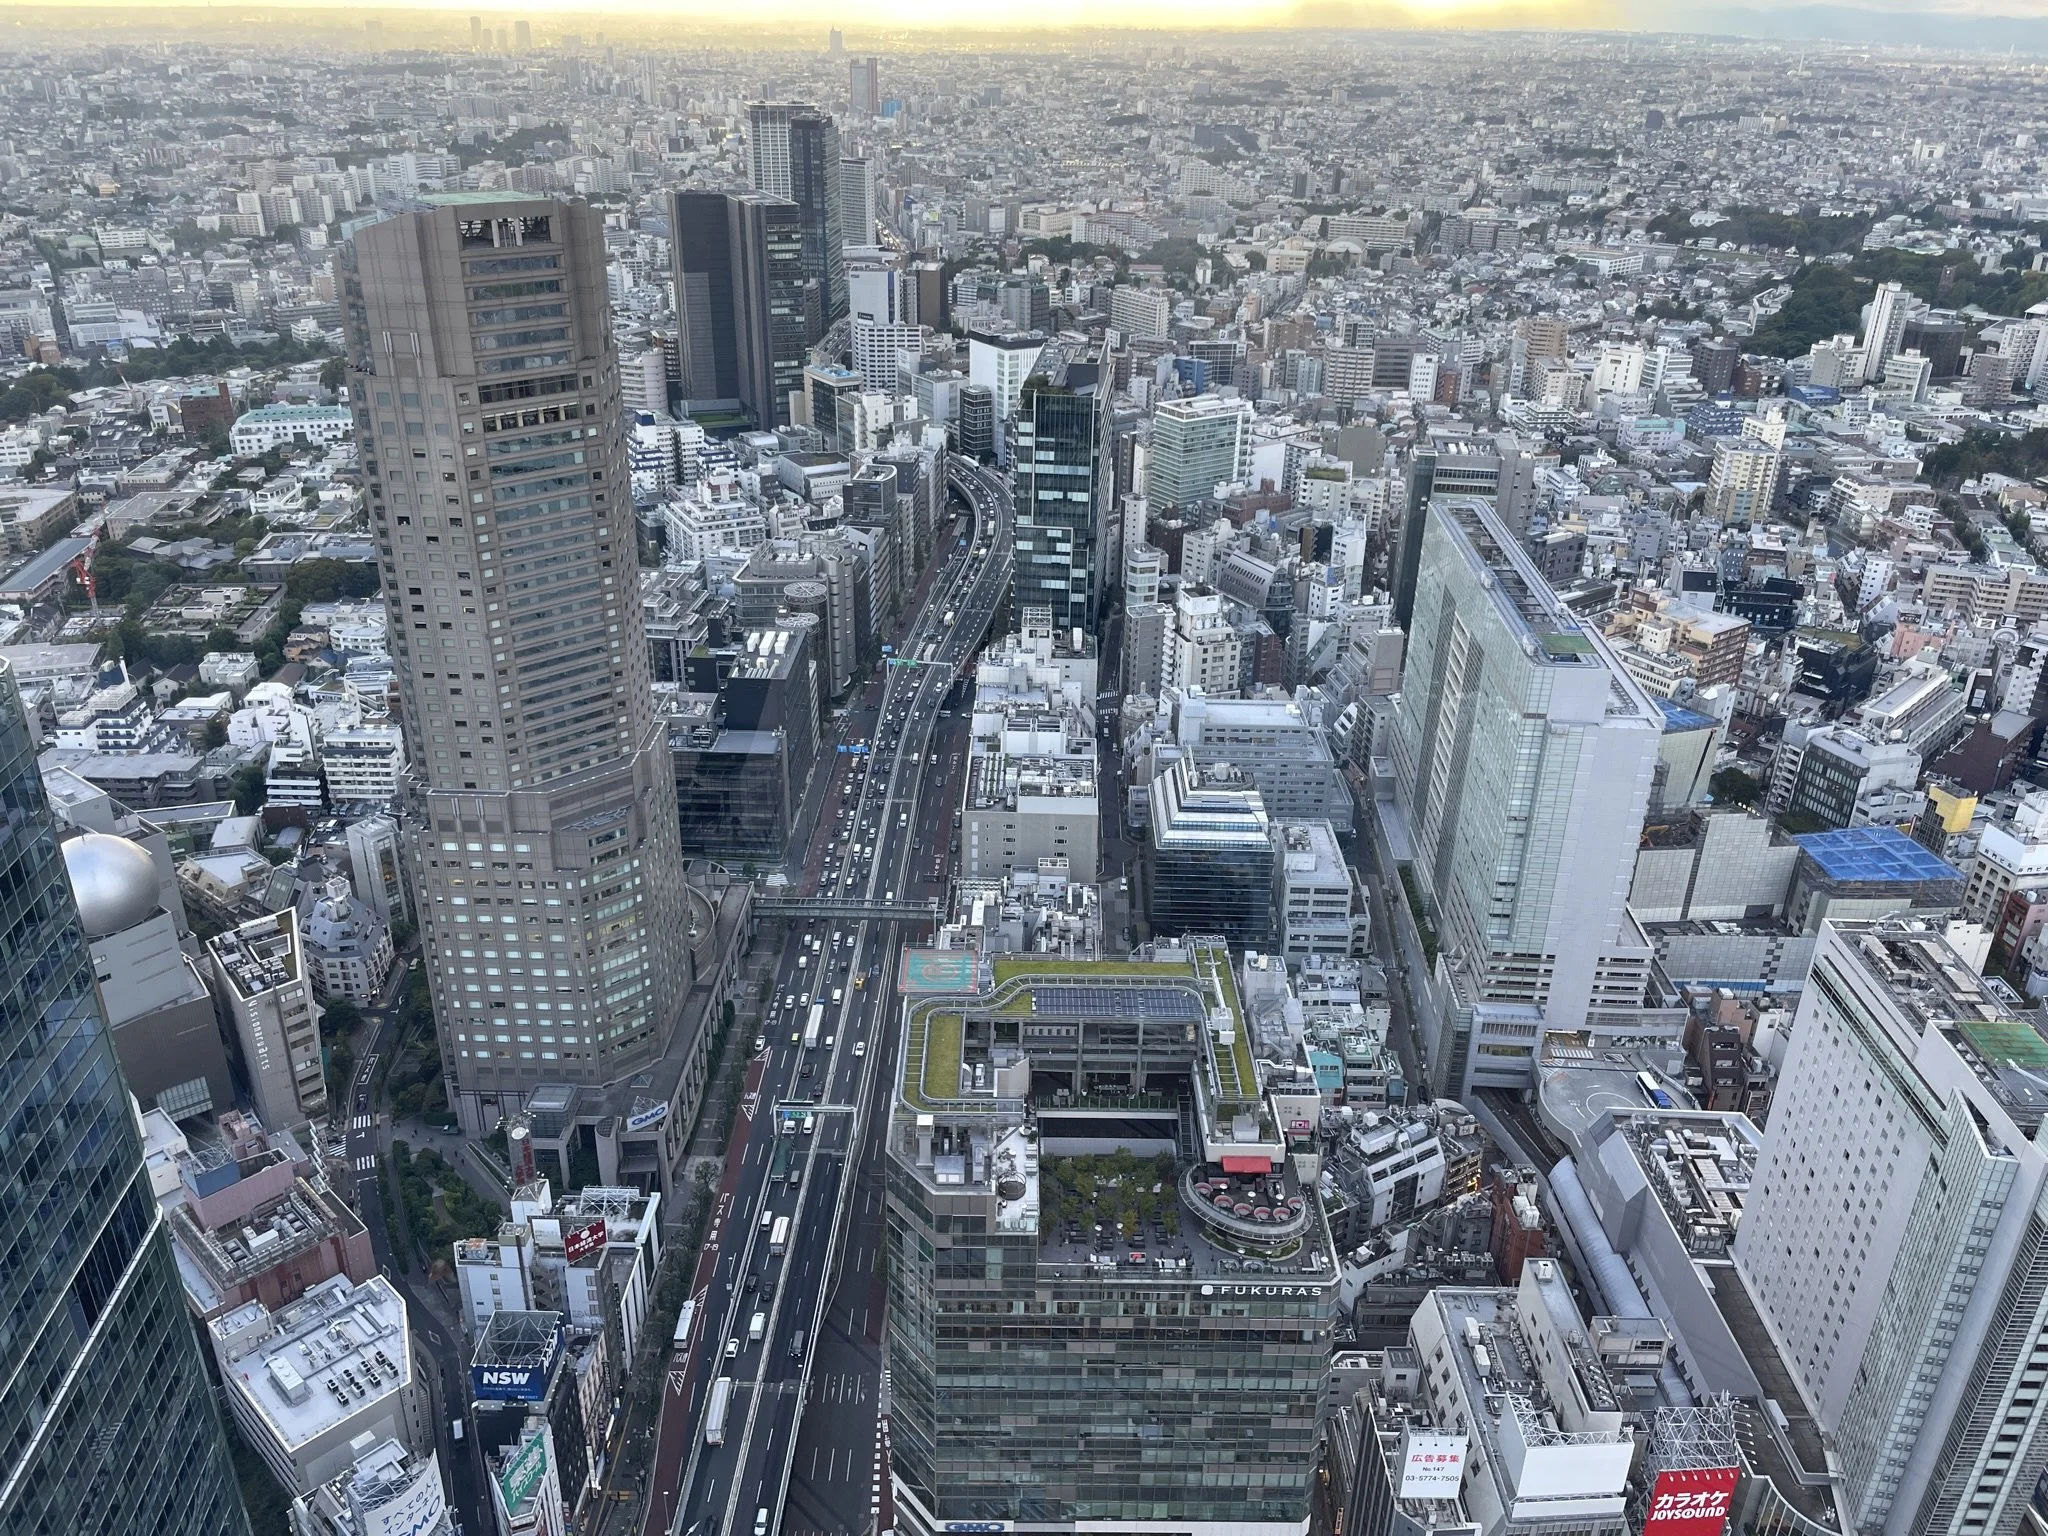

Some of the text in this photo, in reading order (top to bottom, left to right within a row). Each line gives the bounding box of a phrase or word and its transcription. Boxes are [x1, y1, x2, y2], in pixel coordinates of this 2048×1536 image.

[631, 1106, 666, 1126] GMO
[1221, 1285, 1322, 1296] FUKURAS
[482, 1371, 530, 1385] NSW
[1411, 1454, 1460, 1463] 広告募集
[1654, 1490, 1729, 1510] カラオケ
[1650, 1506, 1726, 1521] JOYSOUND
[945, 1522, 1005, 1533] GMO
